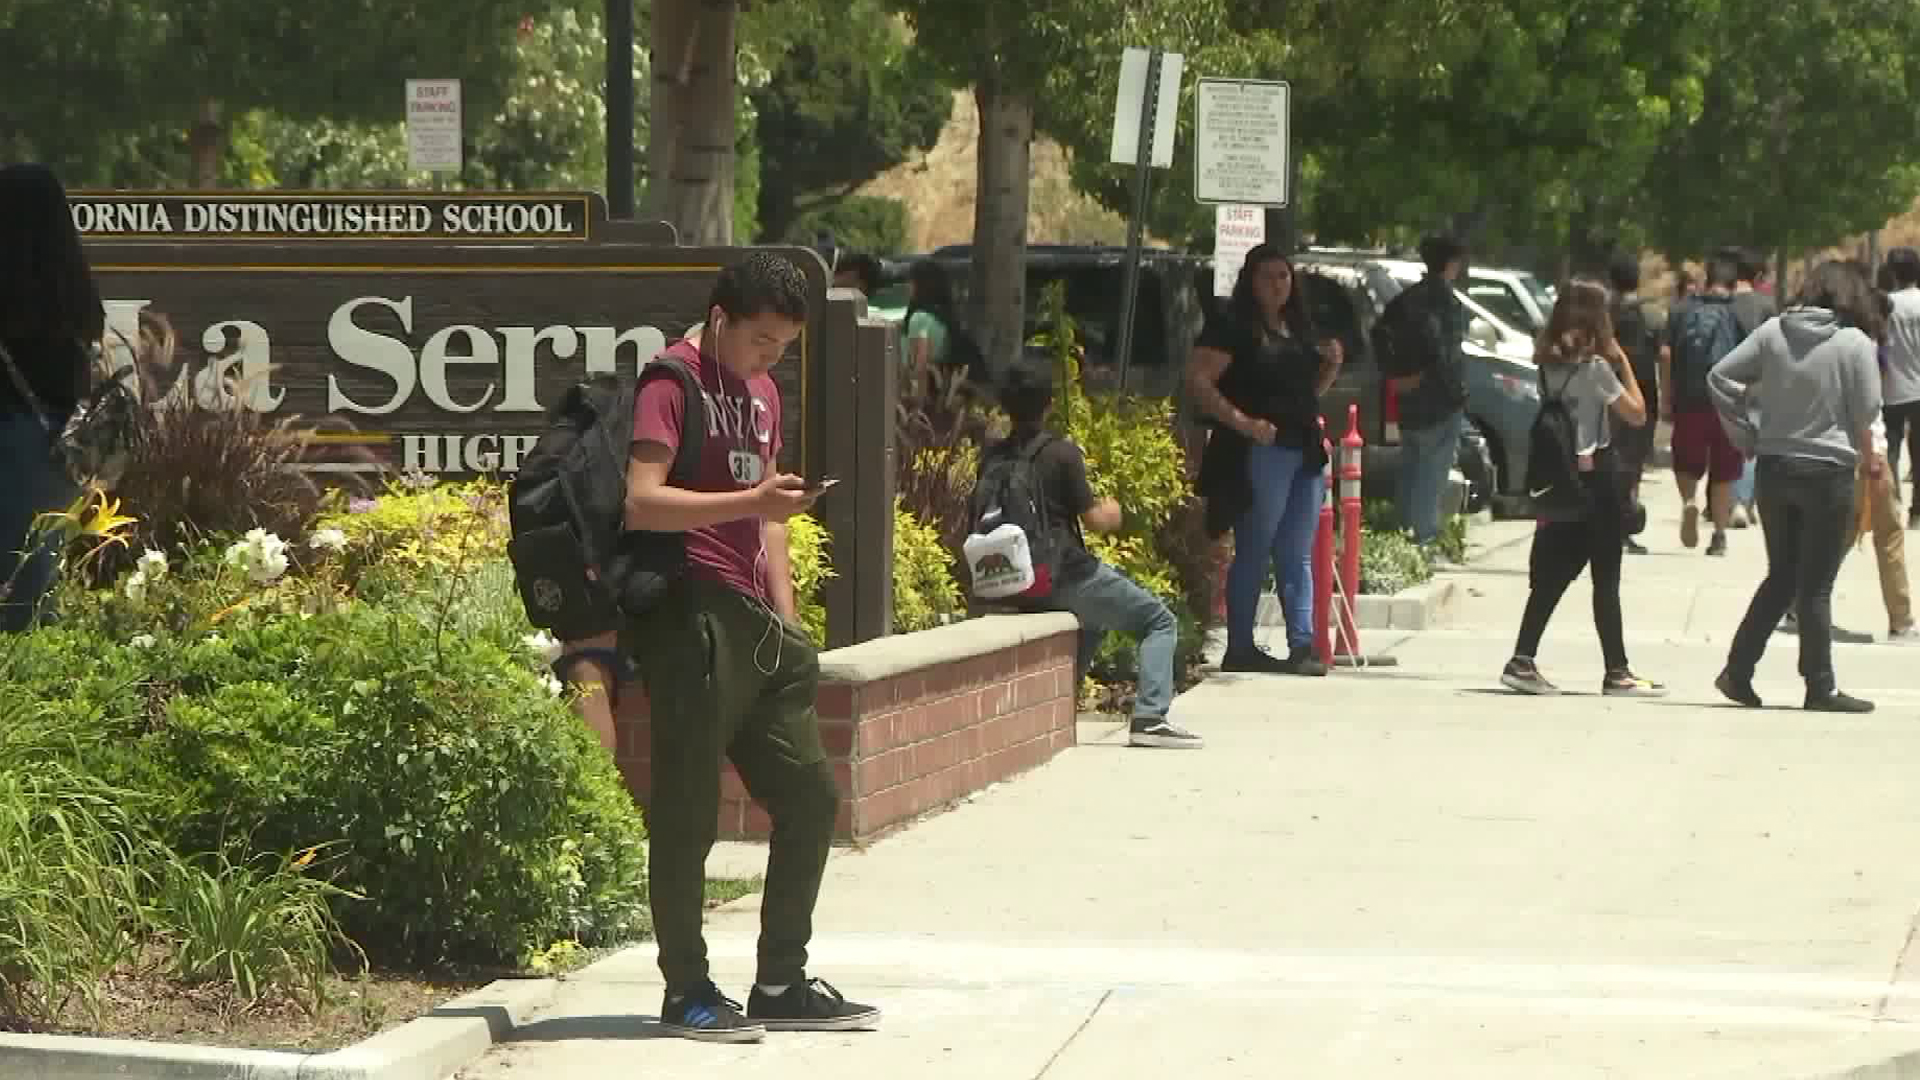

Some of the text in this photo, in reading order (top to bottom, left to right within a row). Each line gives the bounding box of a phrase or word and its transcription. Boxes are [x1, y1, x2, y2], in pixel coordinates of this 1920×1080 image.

[416, 86, 449, 98] STAFF
[410, 101, 456, 113] PARKING
[68, 203, 573, 232] ORNIA DISTINGUISHED SCHOOL
[1226, 209, 1254, 222] STAFF
[1219, 224, 1262, 239] PARKING
[101, 295, 705, 414] La Sern
[703, 394, 770, 444] NYC
[401, 433, 540, 473] HIGH
